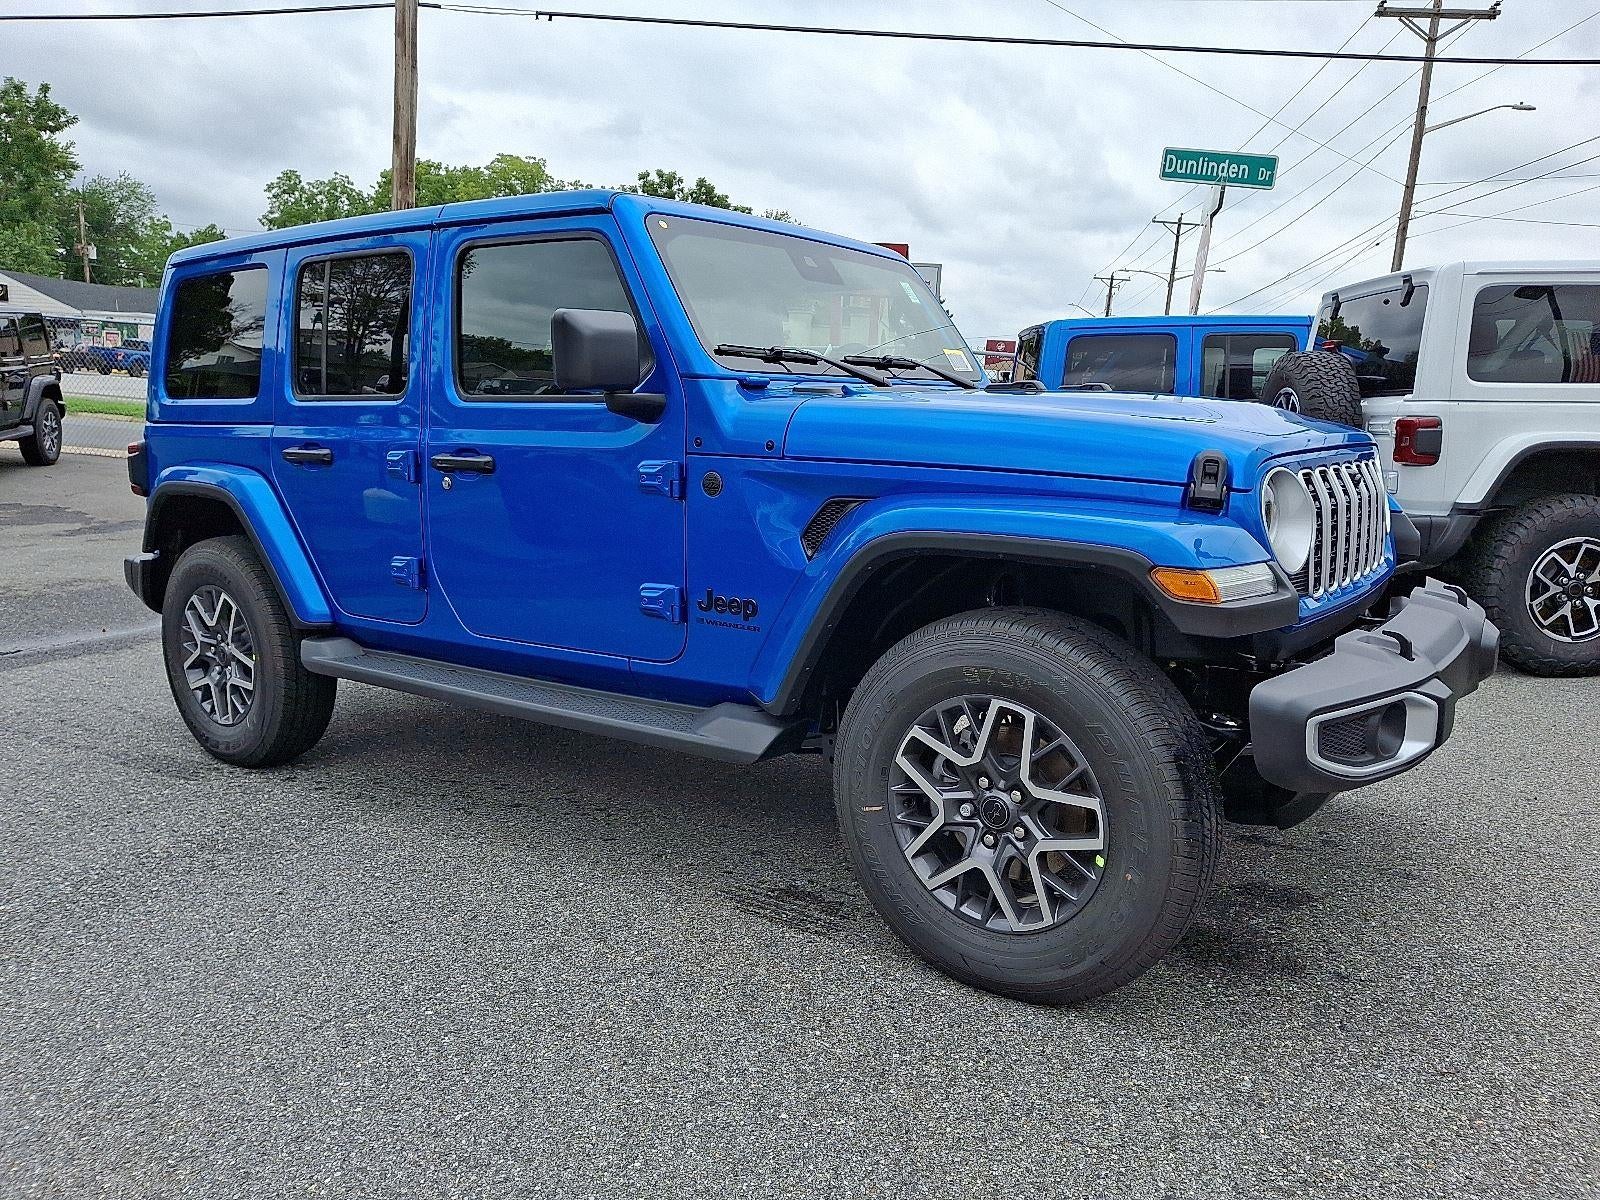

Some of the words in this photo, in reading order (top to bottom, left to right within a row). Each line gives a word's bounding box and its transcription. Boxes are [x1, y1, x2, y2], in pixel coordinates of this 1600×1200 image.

[1165, 154, 1249, 179] Dunlinden
[1258, 167, 1272, 181] Dr
[697, 587, 759, 622] Jeep
